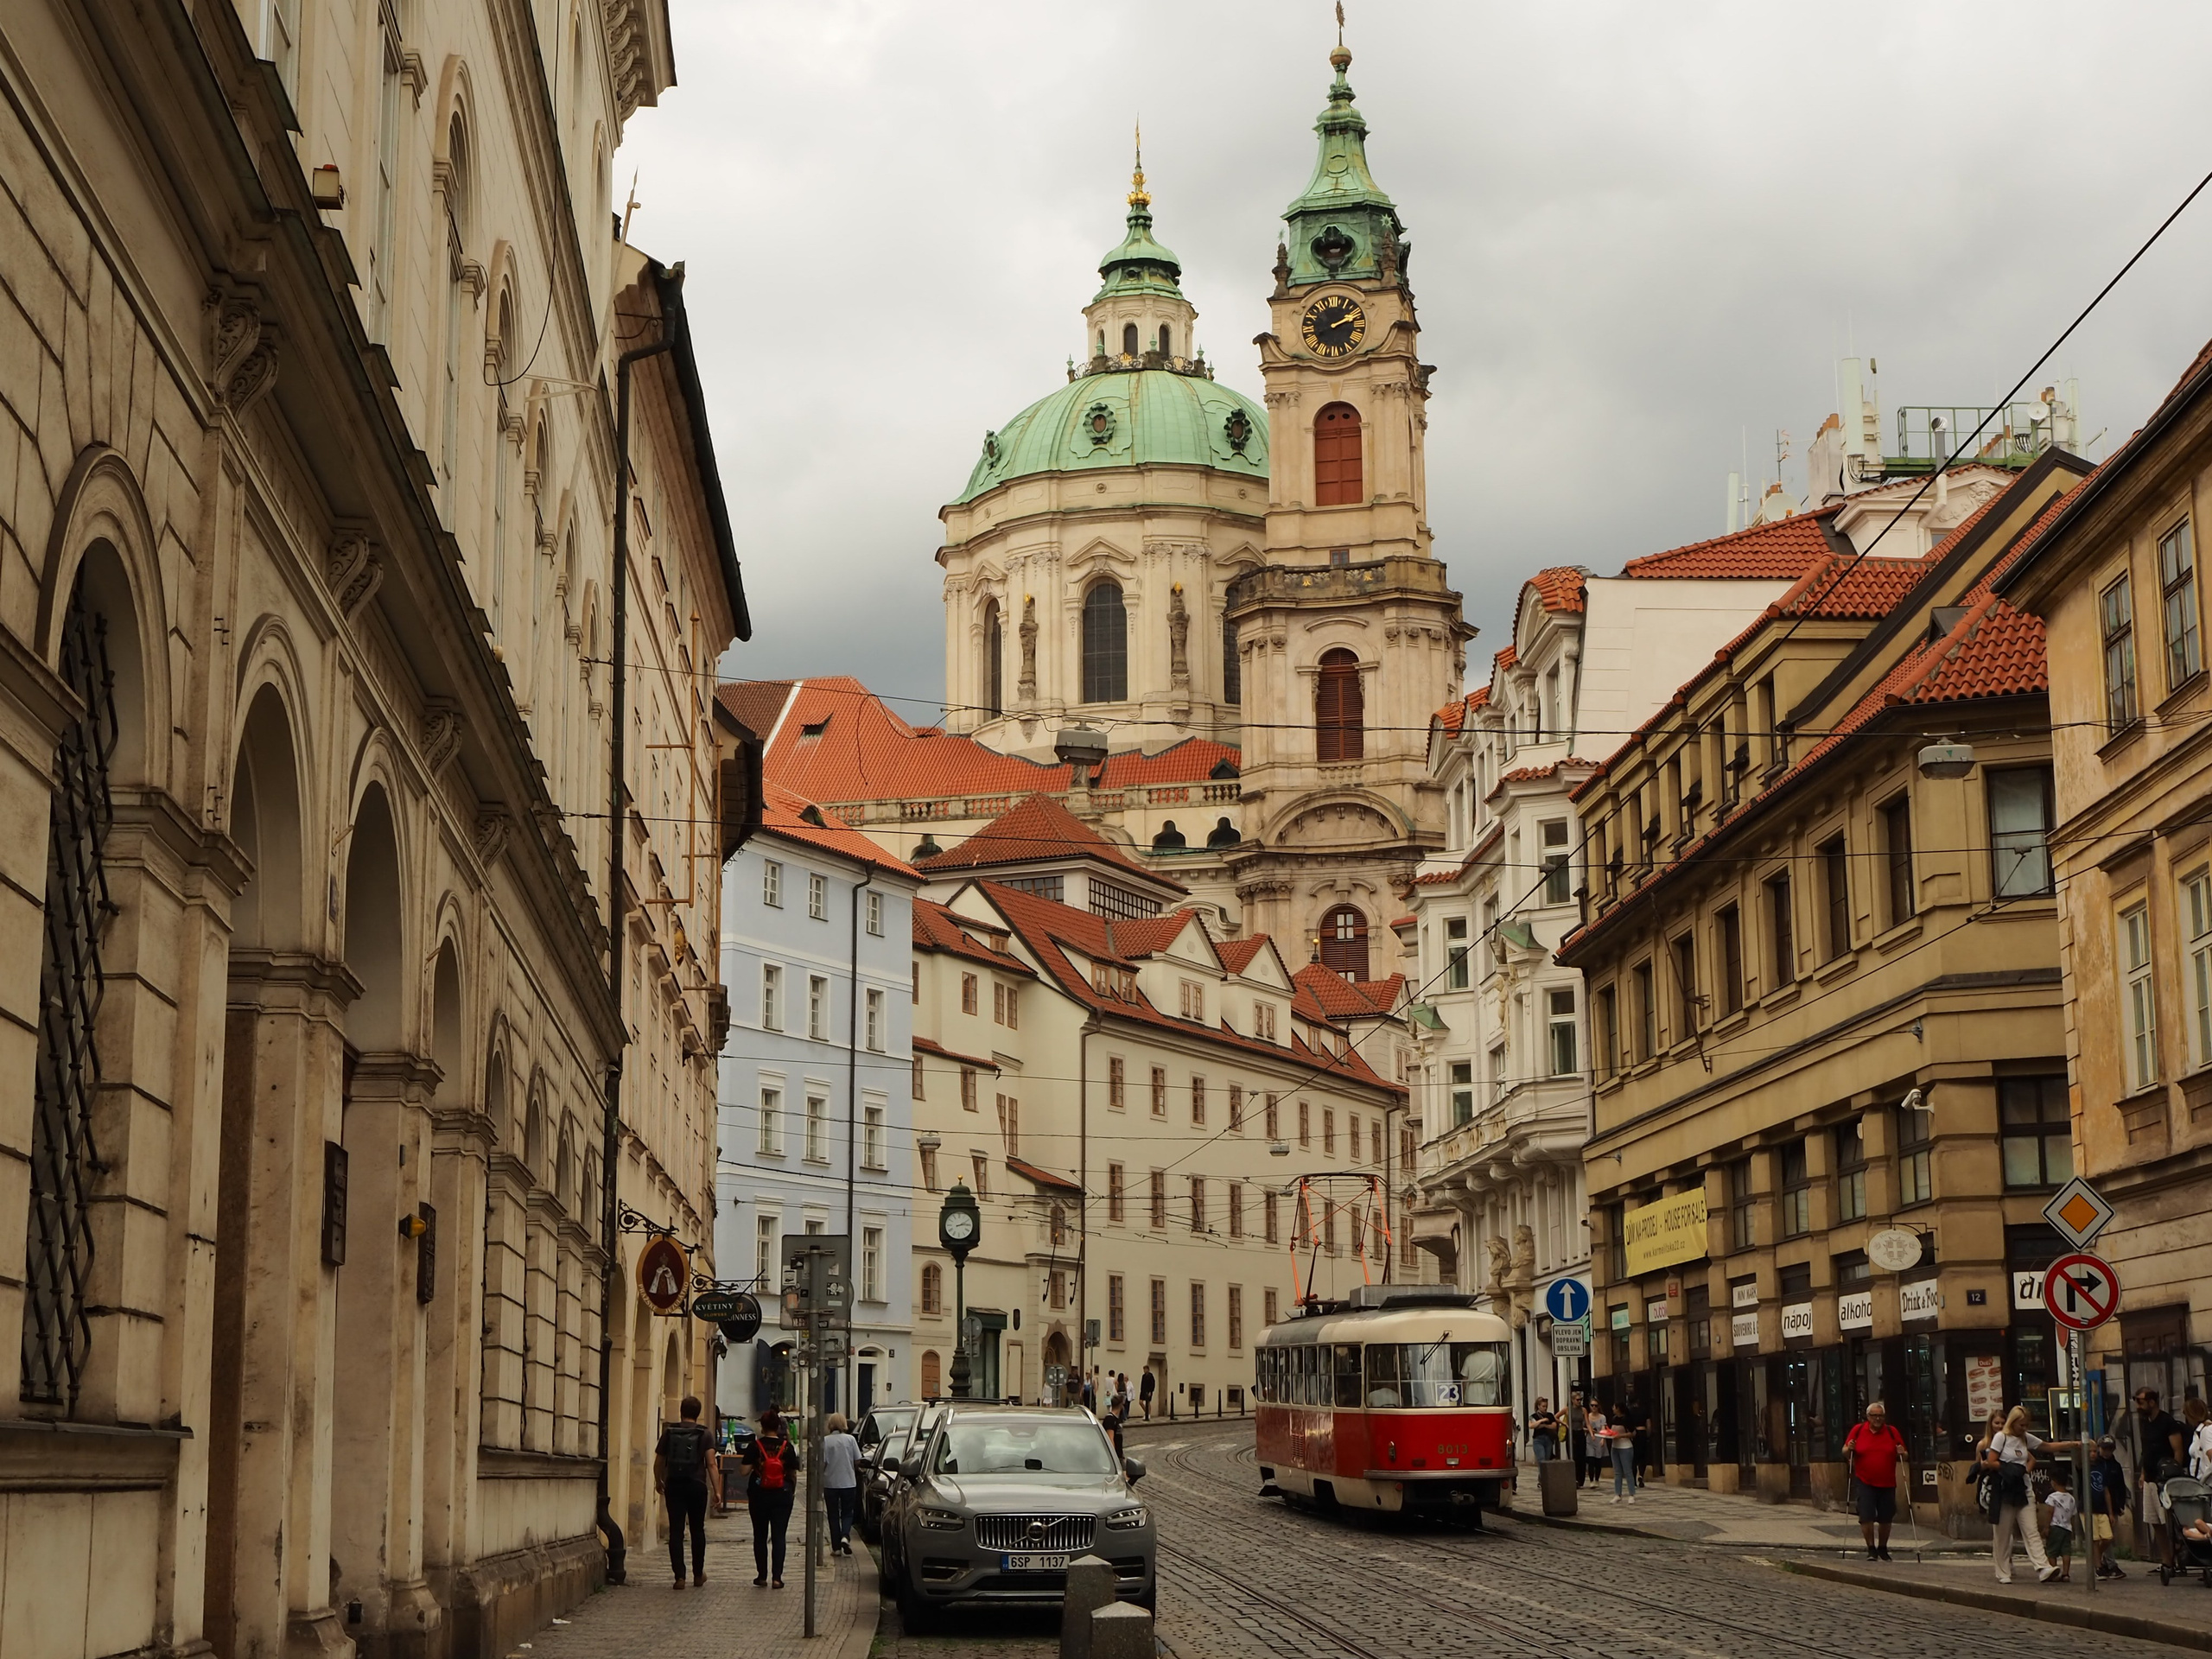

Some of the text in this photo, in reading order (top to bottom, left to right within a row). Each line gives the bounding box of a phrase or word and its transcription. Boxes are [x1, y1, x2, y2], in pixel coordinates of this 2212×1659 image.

[1315, 301, 1325, 312] XI
[1328, 296, 1338, 308] XII
[1306, 312, 1317, 321] X
[1642, 1214, 1658, 1240] PRODEJ
[1664, 1206, 1681, 1233] HOUSE
[1681, 1204, 1691, 1228] FOR
[1691, 1199, 1706, 1224] SALE
[1902, 1291, 1921, 1313] Drink
[1971, 1293, 1980, 1301] 12
[696, 1302, 734, 1311] KVĚTINY
[1784, 1309, 1812, 1332] nápoj
[1439, 1385, 1459, 1402] 23
[1438, 1444, 1468, 1454] 8013
[1011, 1556, 1031, 1568] 6SP
[1039, 1556, 1065, 1568] 1137
